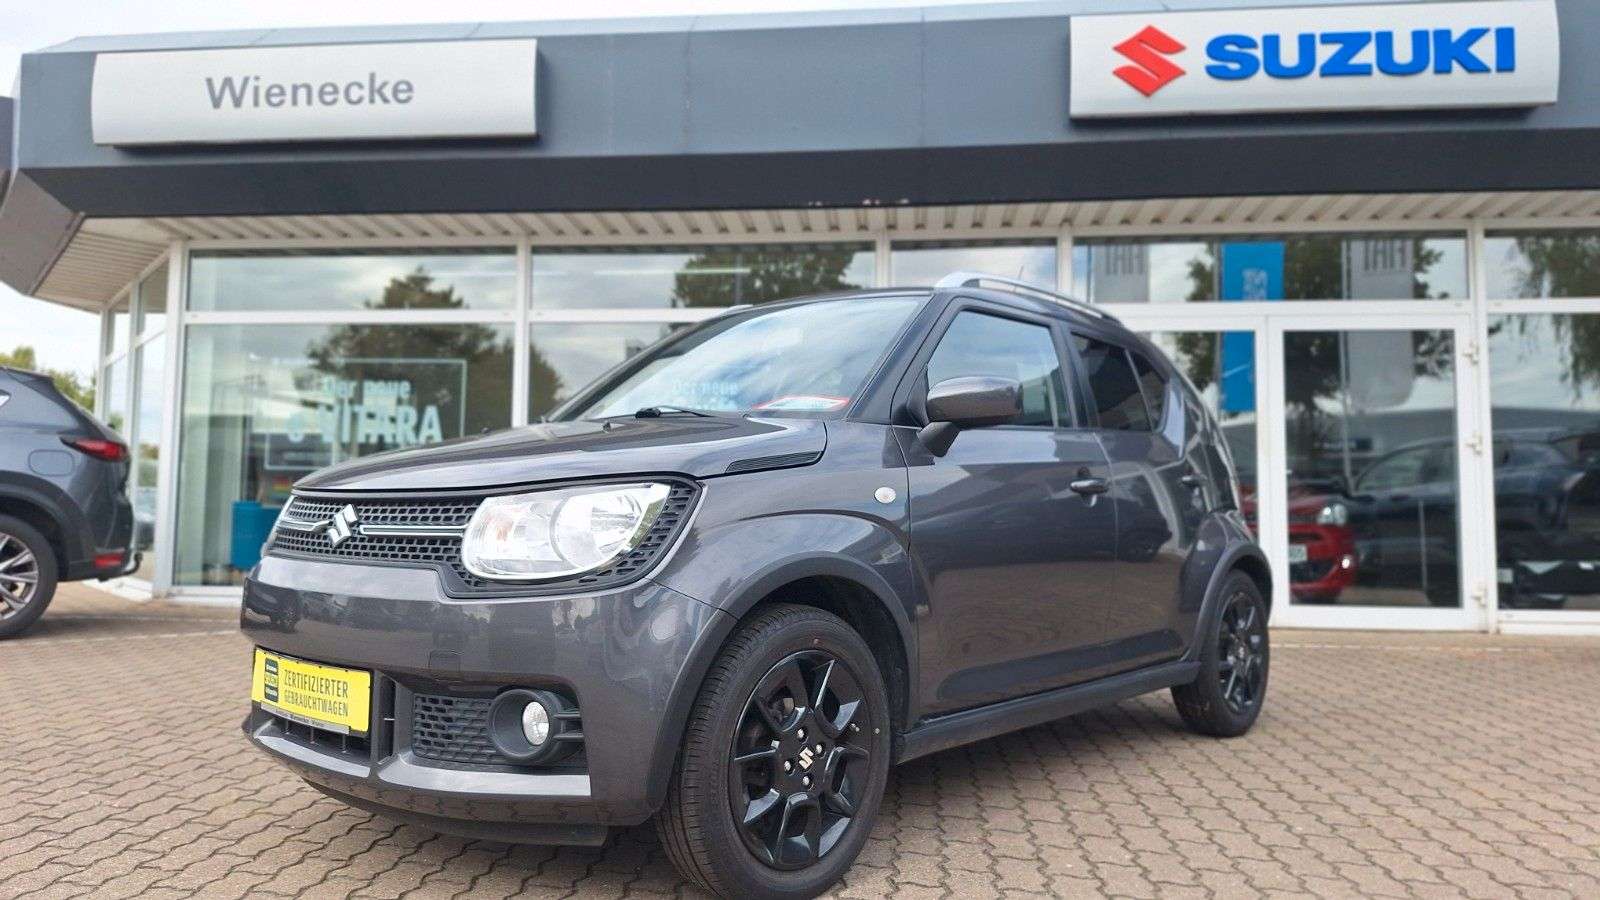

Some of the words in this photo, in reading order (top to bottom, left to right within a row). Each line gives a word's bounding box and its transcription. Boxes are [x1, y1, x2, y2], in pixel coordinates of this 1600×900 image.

[1205, 27, 1515, 81] SUZUKI
[205, 72, 415, 110] Wienecke
[284, 669, 349, 698] ZERTIFIZIERTER
[284, 689, 349, 717] GEBRAUCHTWAGEN
